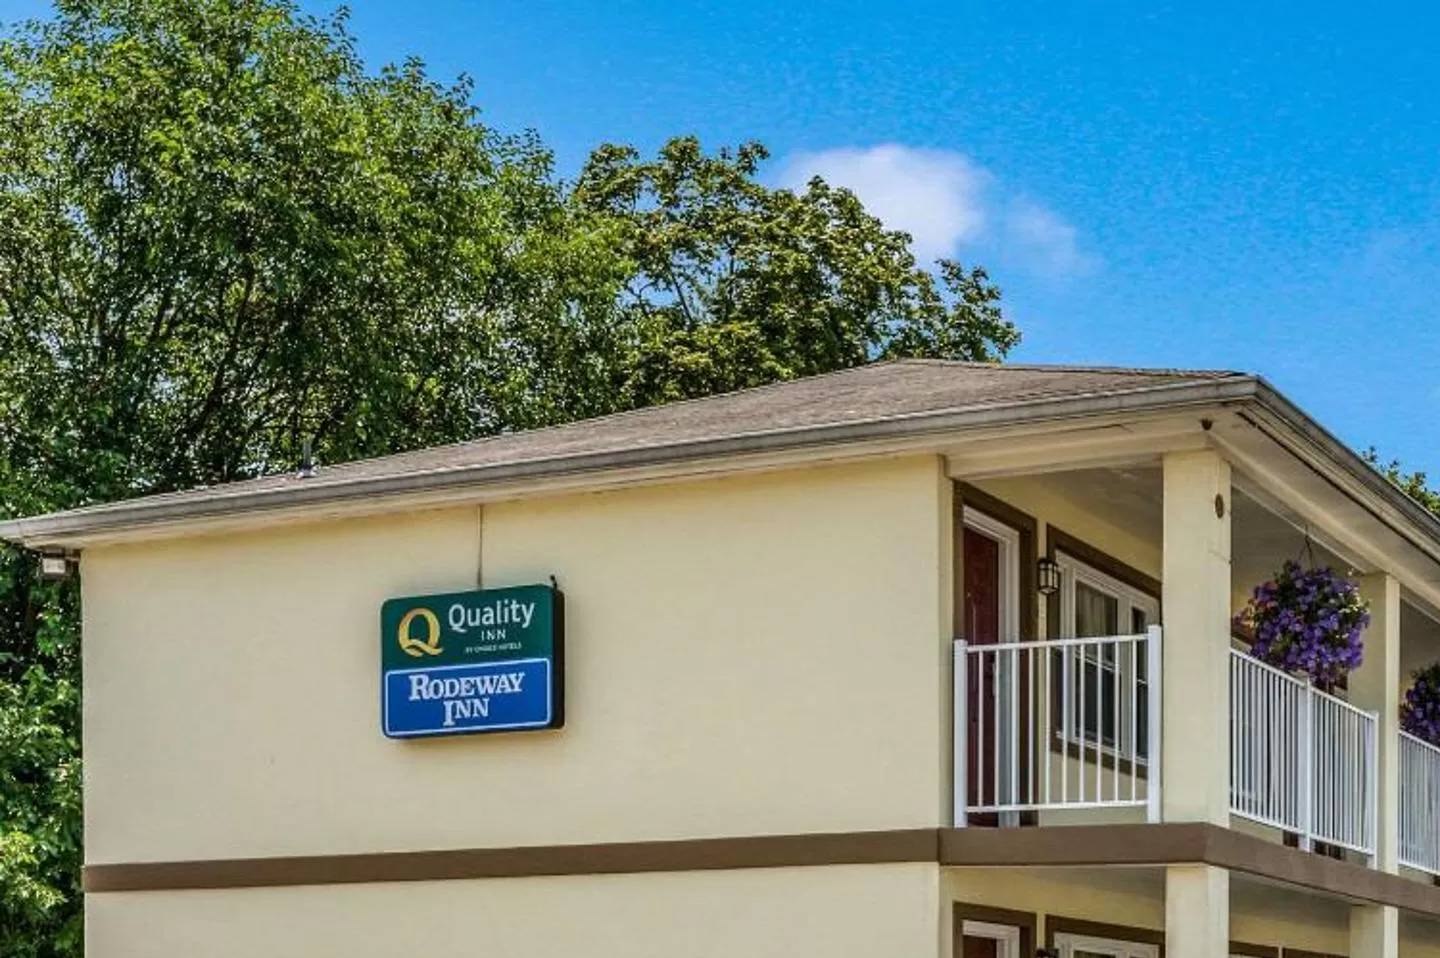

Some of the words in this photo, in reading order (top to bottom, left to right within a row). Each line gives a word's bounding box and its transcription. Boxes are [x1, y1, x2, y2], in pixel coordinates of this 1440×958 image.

[448, 599, 535, 633] Quality
[398, 608, 444, 657] Q
[481, 629, 506, 641] INN
[409, 672, 525, 701] RODEWAY
[443, 698, 490, 726] INN
